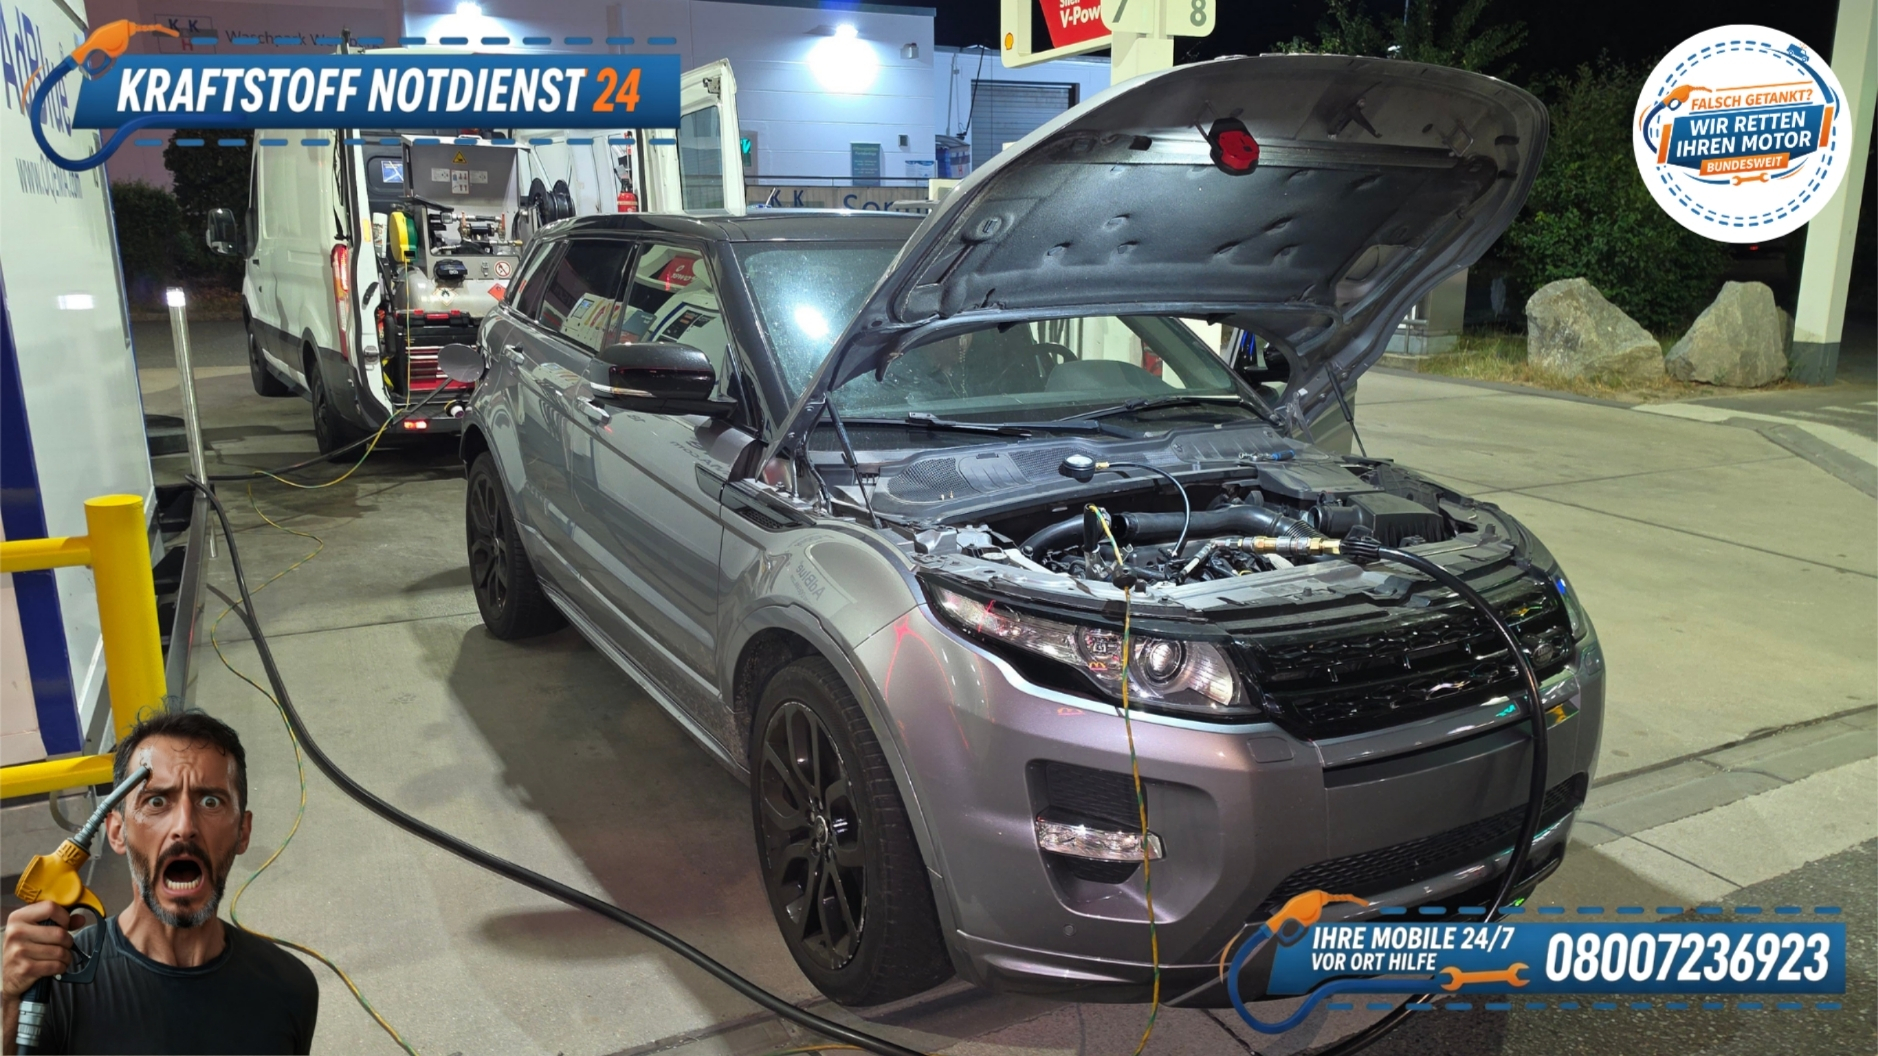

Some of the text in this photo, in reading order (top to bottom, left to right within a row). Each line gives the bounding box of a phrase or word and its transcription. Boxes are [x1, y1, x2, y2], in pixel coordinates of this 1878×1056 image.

[1059, 0, 1080, 8] She
[1190, 0, 1207, 27] 8
[0, 0, 72, 137] AdBlue
